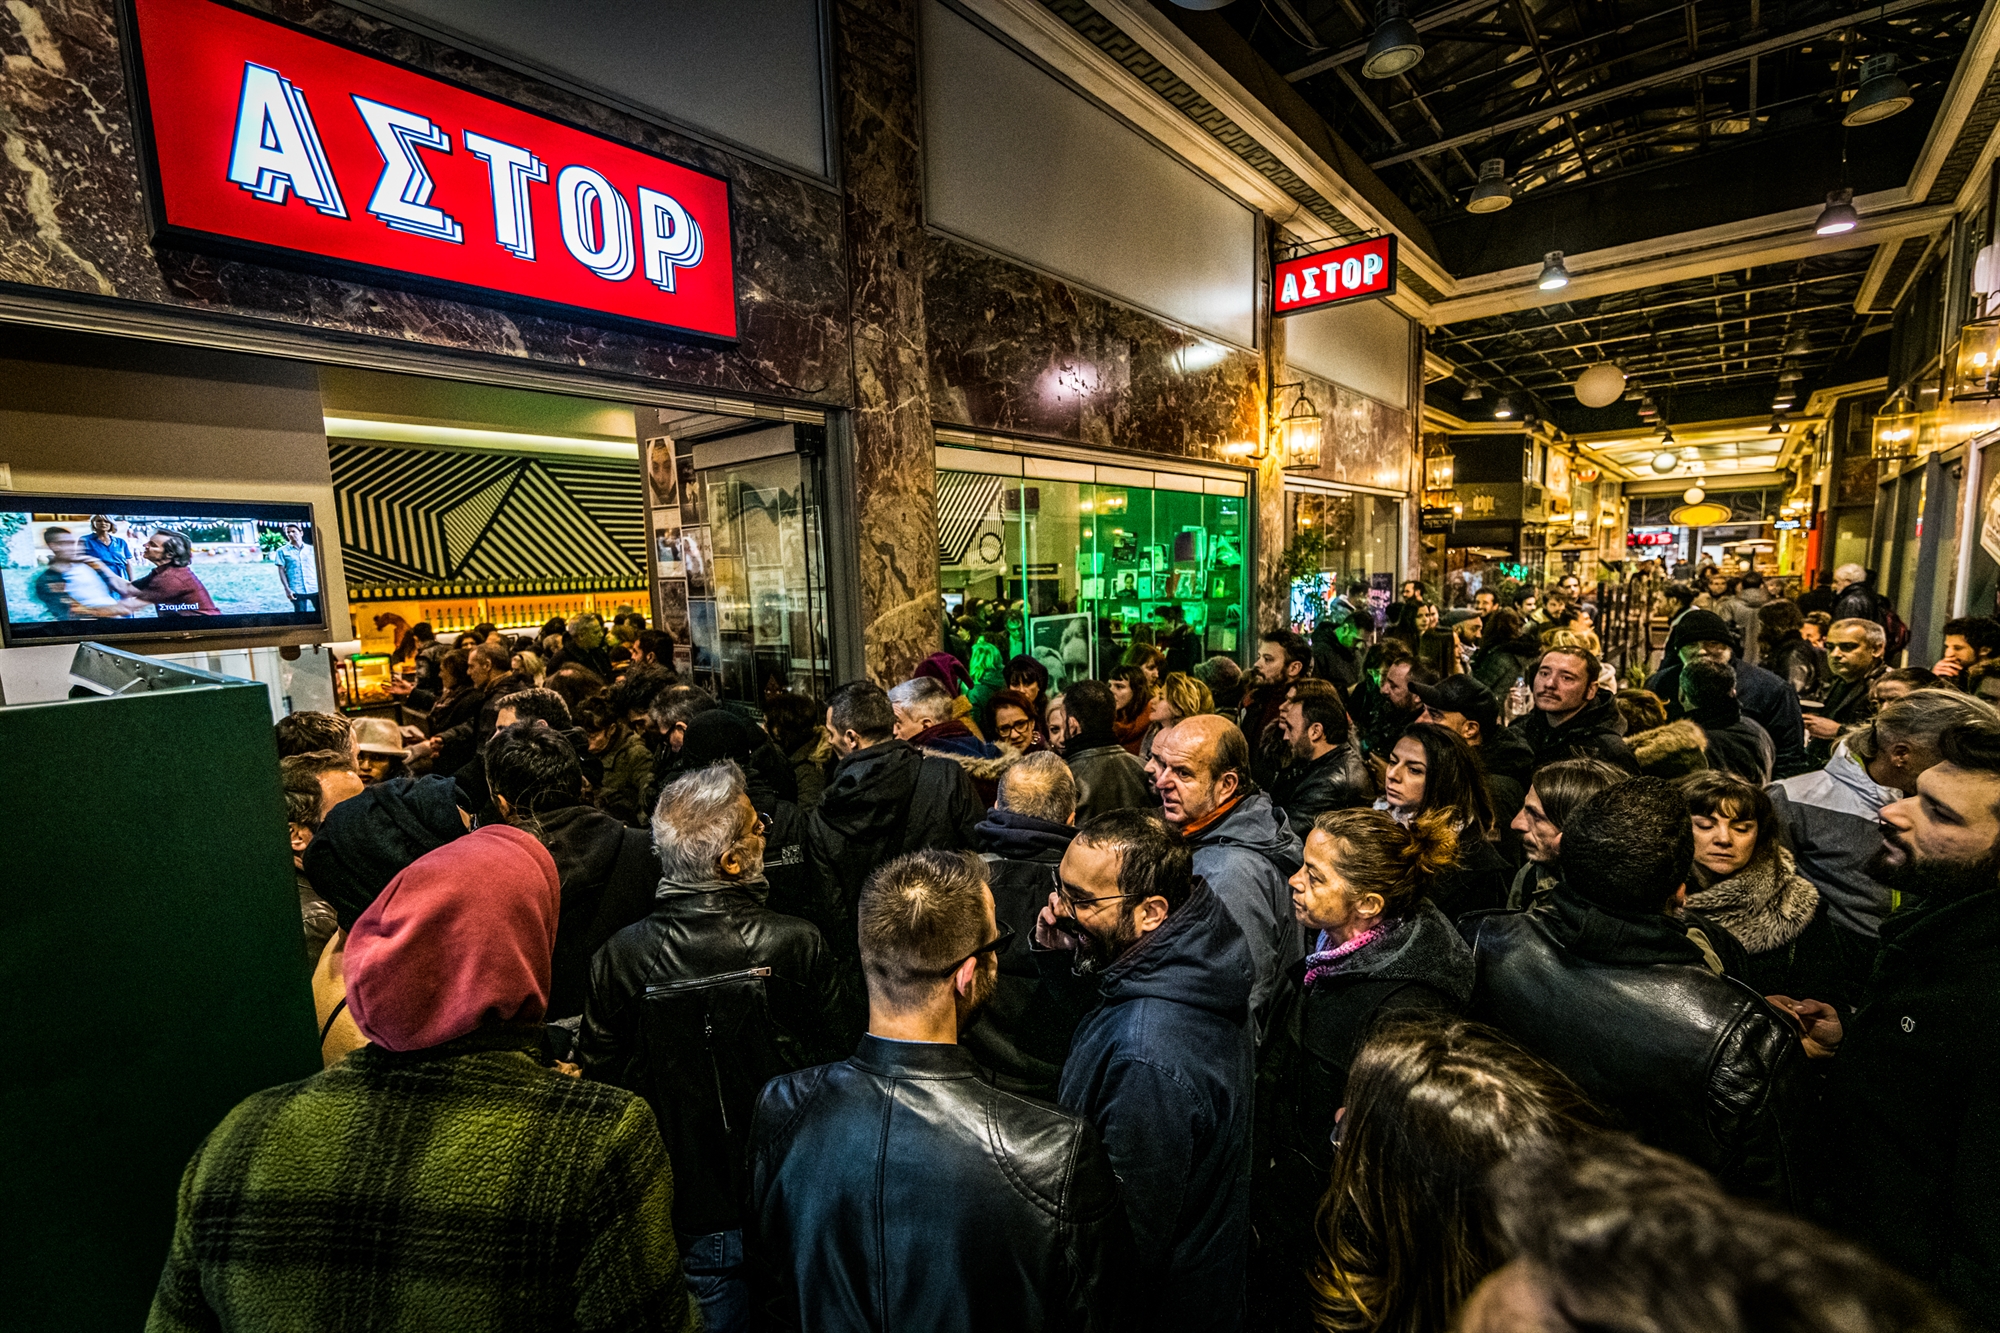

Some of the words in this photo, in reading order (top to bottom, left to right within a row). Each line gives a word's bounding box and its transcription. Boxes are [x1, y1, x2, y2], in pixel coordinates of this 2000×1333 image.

[226, 59, 706, 295] ΑΣΤΟΡ
[1280, 252, 1384, 304] ΑΣΤΟΡ
[158, 602, 200, 612] Σταμάτα!
